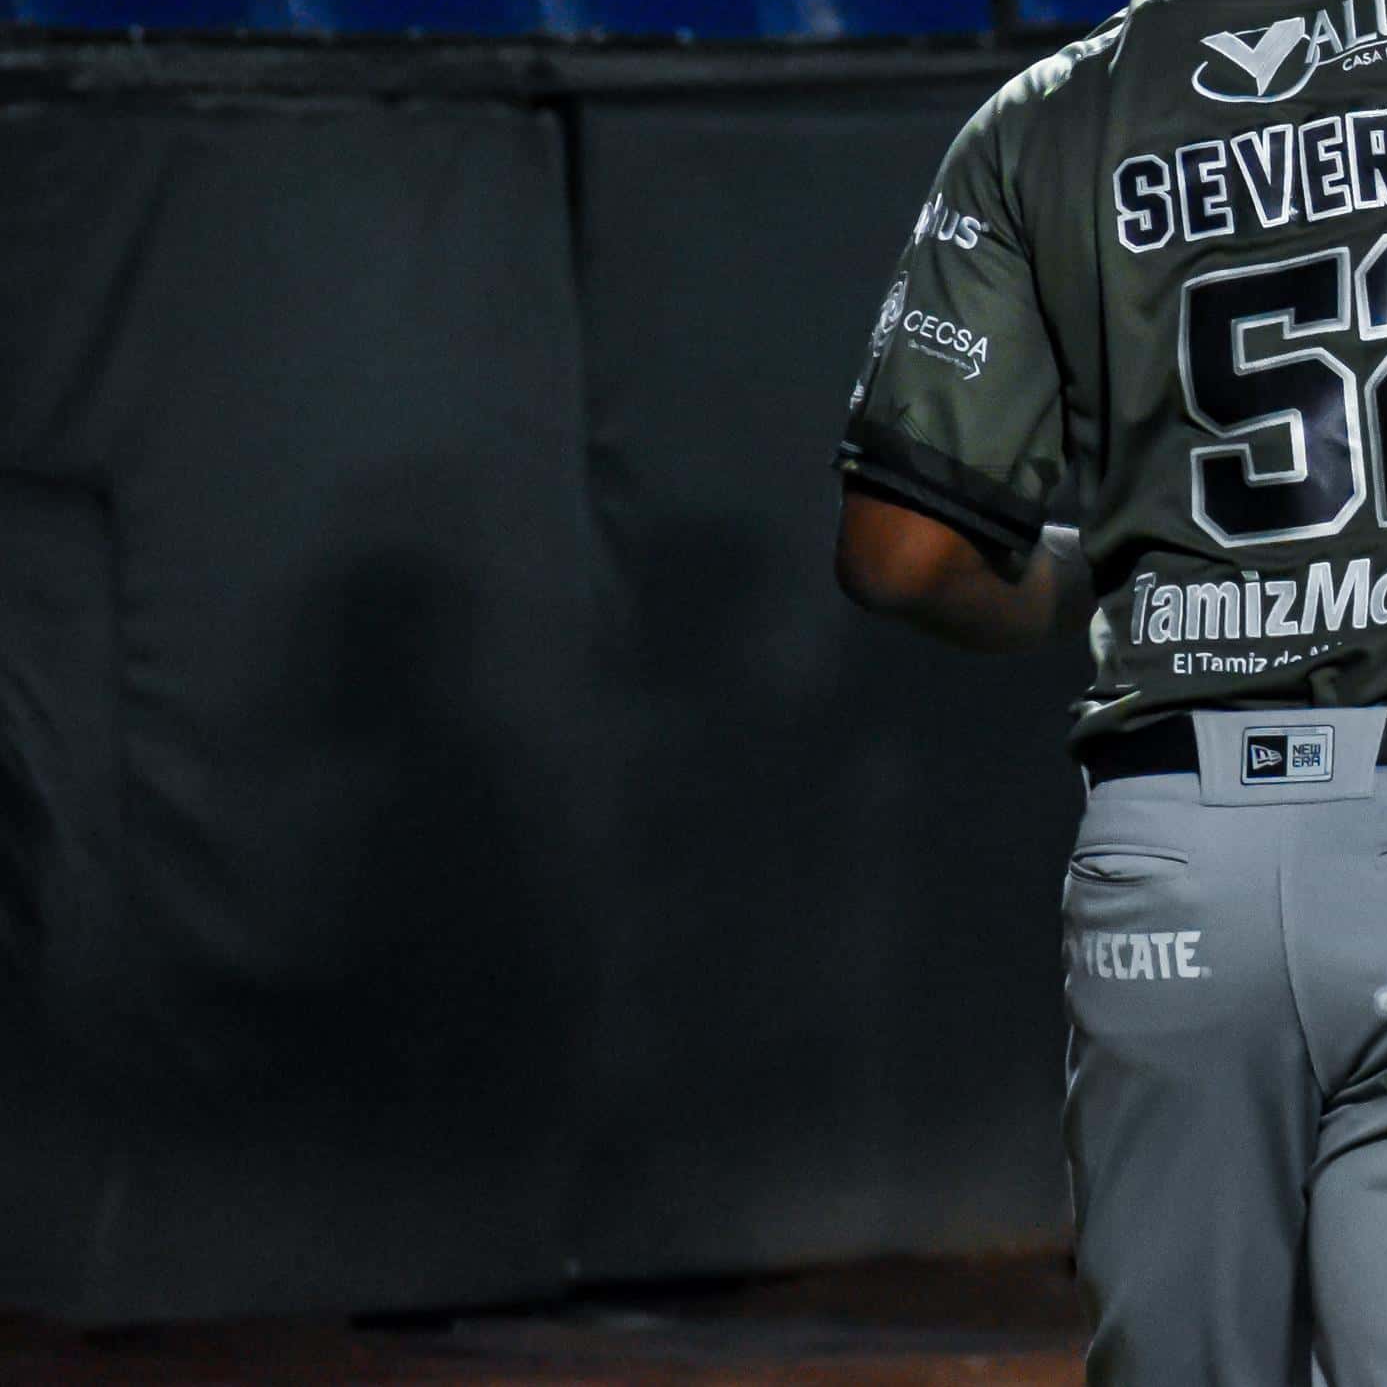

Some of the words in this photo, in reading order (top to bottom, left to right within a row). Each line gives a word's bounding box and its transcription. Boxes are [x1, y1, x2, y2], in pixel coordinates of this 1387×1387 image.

[1342, 48, 1384, 72] CASA
[903, 309, 990, 364] CECSA
[1173, 653, 1193, 675] El
[1200, 650, 1268, 675] Tamiz
[1082, 929, 1204, 981] TECATE
